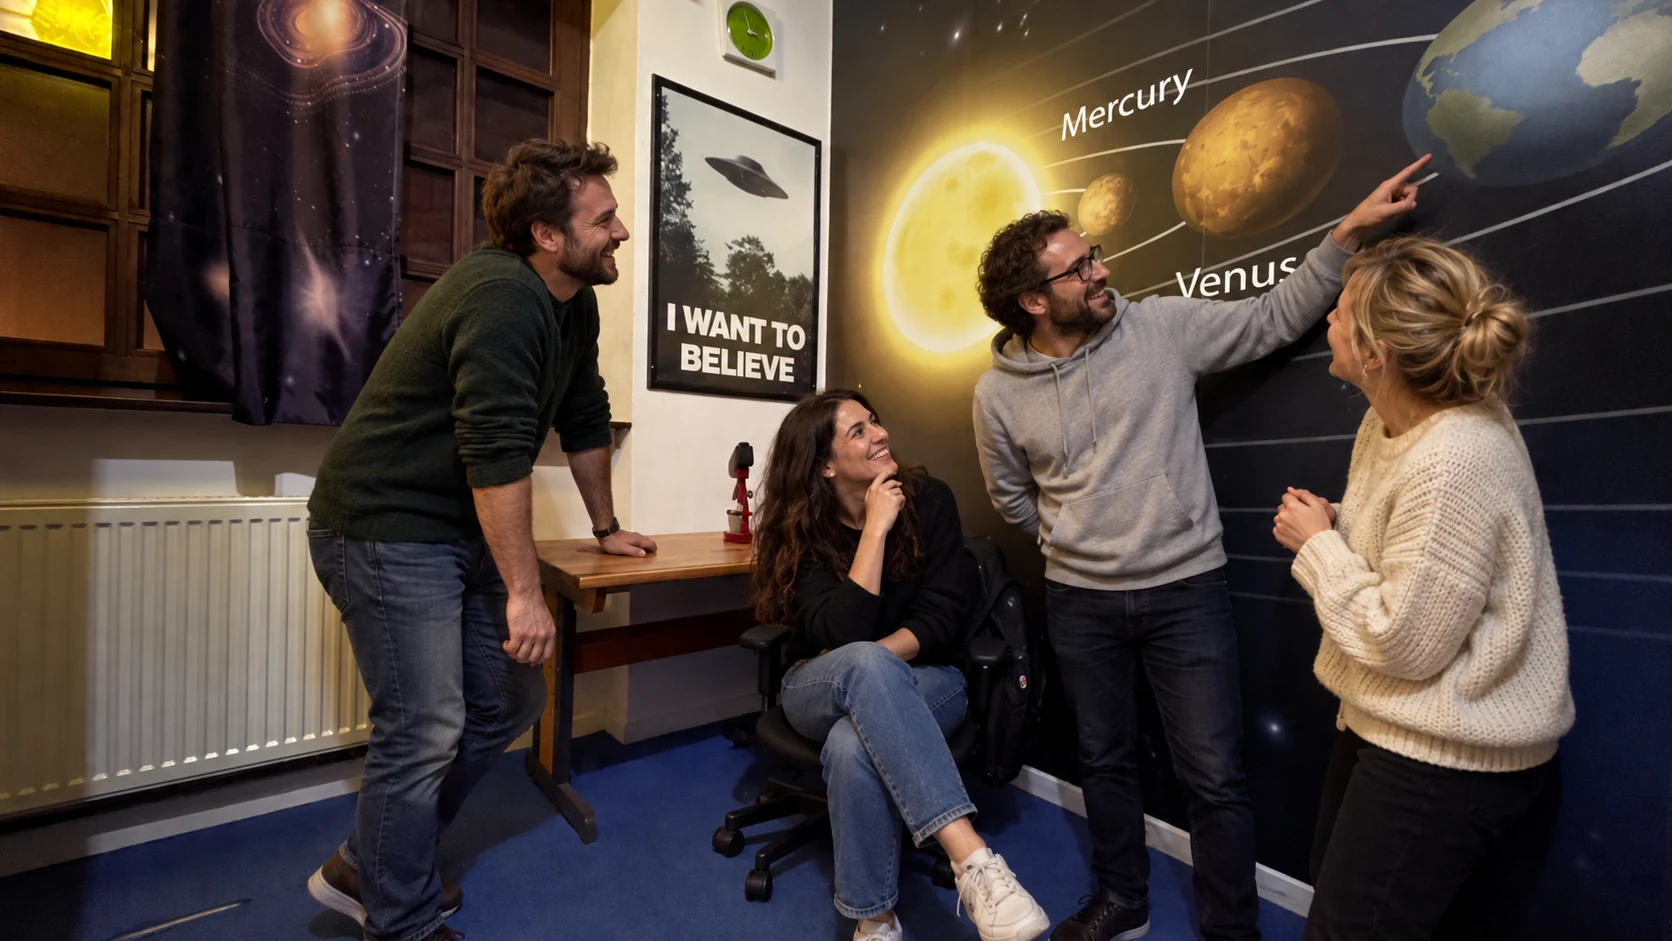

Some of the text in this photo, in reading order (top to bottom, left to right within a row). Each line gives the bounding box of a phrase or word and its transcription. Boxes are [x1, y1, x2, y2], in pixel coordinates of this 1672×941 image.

[1061, 68, 1194, 141] Mercury
[1175, 256, 1297, 298] Venus
[667, 303, 806, 350] I WANT TO
[680, 343, 795, 383] BELIEVE
